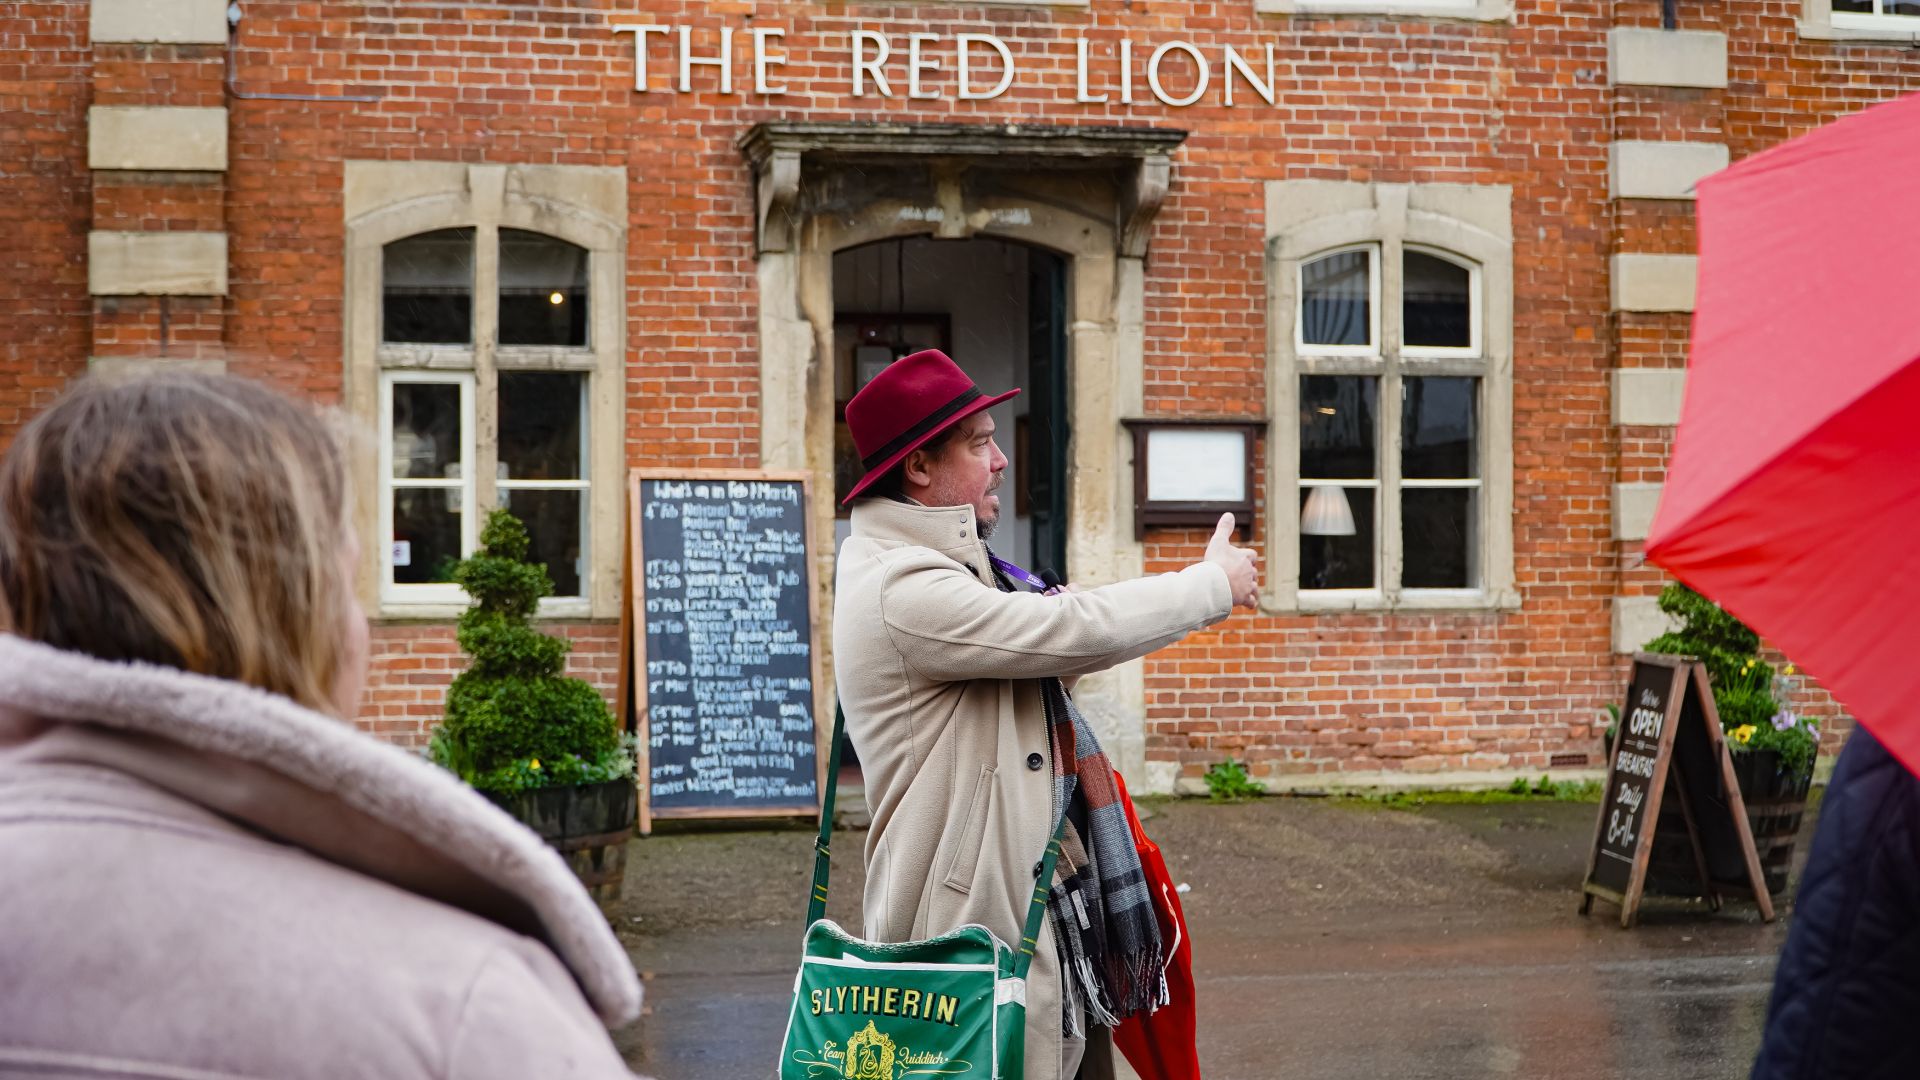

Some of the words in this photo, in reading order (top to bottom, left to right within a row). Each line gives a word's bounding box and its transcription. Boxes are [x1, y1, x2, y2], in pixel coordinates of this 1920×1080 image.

[612, 24, 788, 95] THE
[851, 29, 1016, 102] RED
[1076, 36, 1277, 107] LION
[654, 480, 693, 499] What's
[711, 485, 725, 499] in
[727, 481, 750, 499] Feb
[758, 482, 799, 506] March
[660, 502, 679, 519] Feb
[731, 501, 785, 519] Yorkshire
[754, 541, 783, 552] could
[663, 559, 681, 574] Feb
[663, 573, 682, 589] Feb
[776, 569, 800, 587] Pub
[663, 598, 682, 612] Feb
[665, 619, 684, 634] Feb
[666, 660, 687, 676] Feb
[690, 663, 714, 677] Pub
[715, 663, 742, 677] Quiz
[664, 679, 690, 693] Mar
[751, 675, 765, 689] @
[671, 704, 695, 718] Mar
[672, 720, 696, 733] Mar
[1630, 708, 1663, 739] OPEN
[672, 734, 697, 746] Mar
[1616, 750, 1656, 777] BREAKFAS
[1616, 782, 1643, 813] Daily
[811, 985, 960, 1026] SLYTHERIN
[824, 1040, 846, 1061] Team
[896, 1046, 945, 1069] Quidditch
